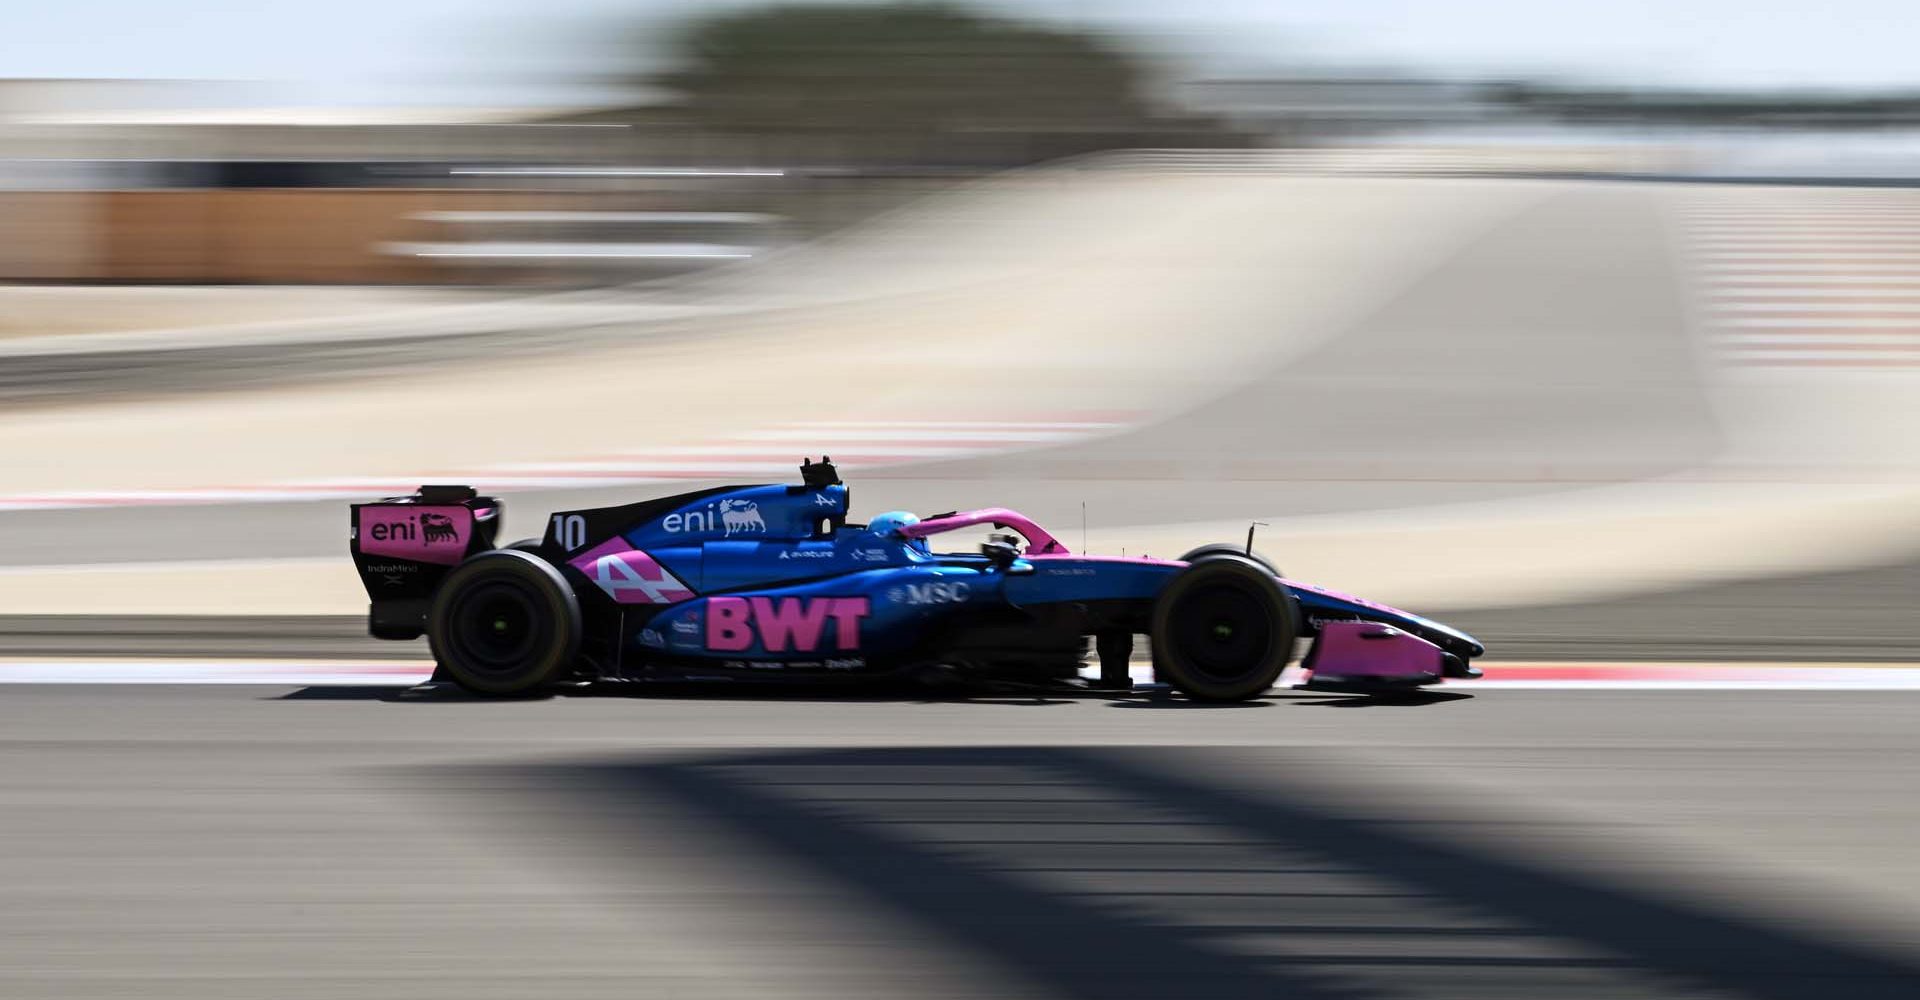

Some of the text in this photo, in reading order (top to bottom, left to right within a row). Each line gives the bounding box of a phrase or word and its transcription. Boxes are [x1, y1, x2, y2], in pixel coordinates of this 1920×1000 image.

[371, 516, 416, 541] eni
[553, 514, 586, 552] 10
[662, 503, 715, 533] eni
[907, 582, 969, 605] MSC
[707, 596, 870, 652] BWT
